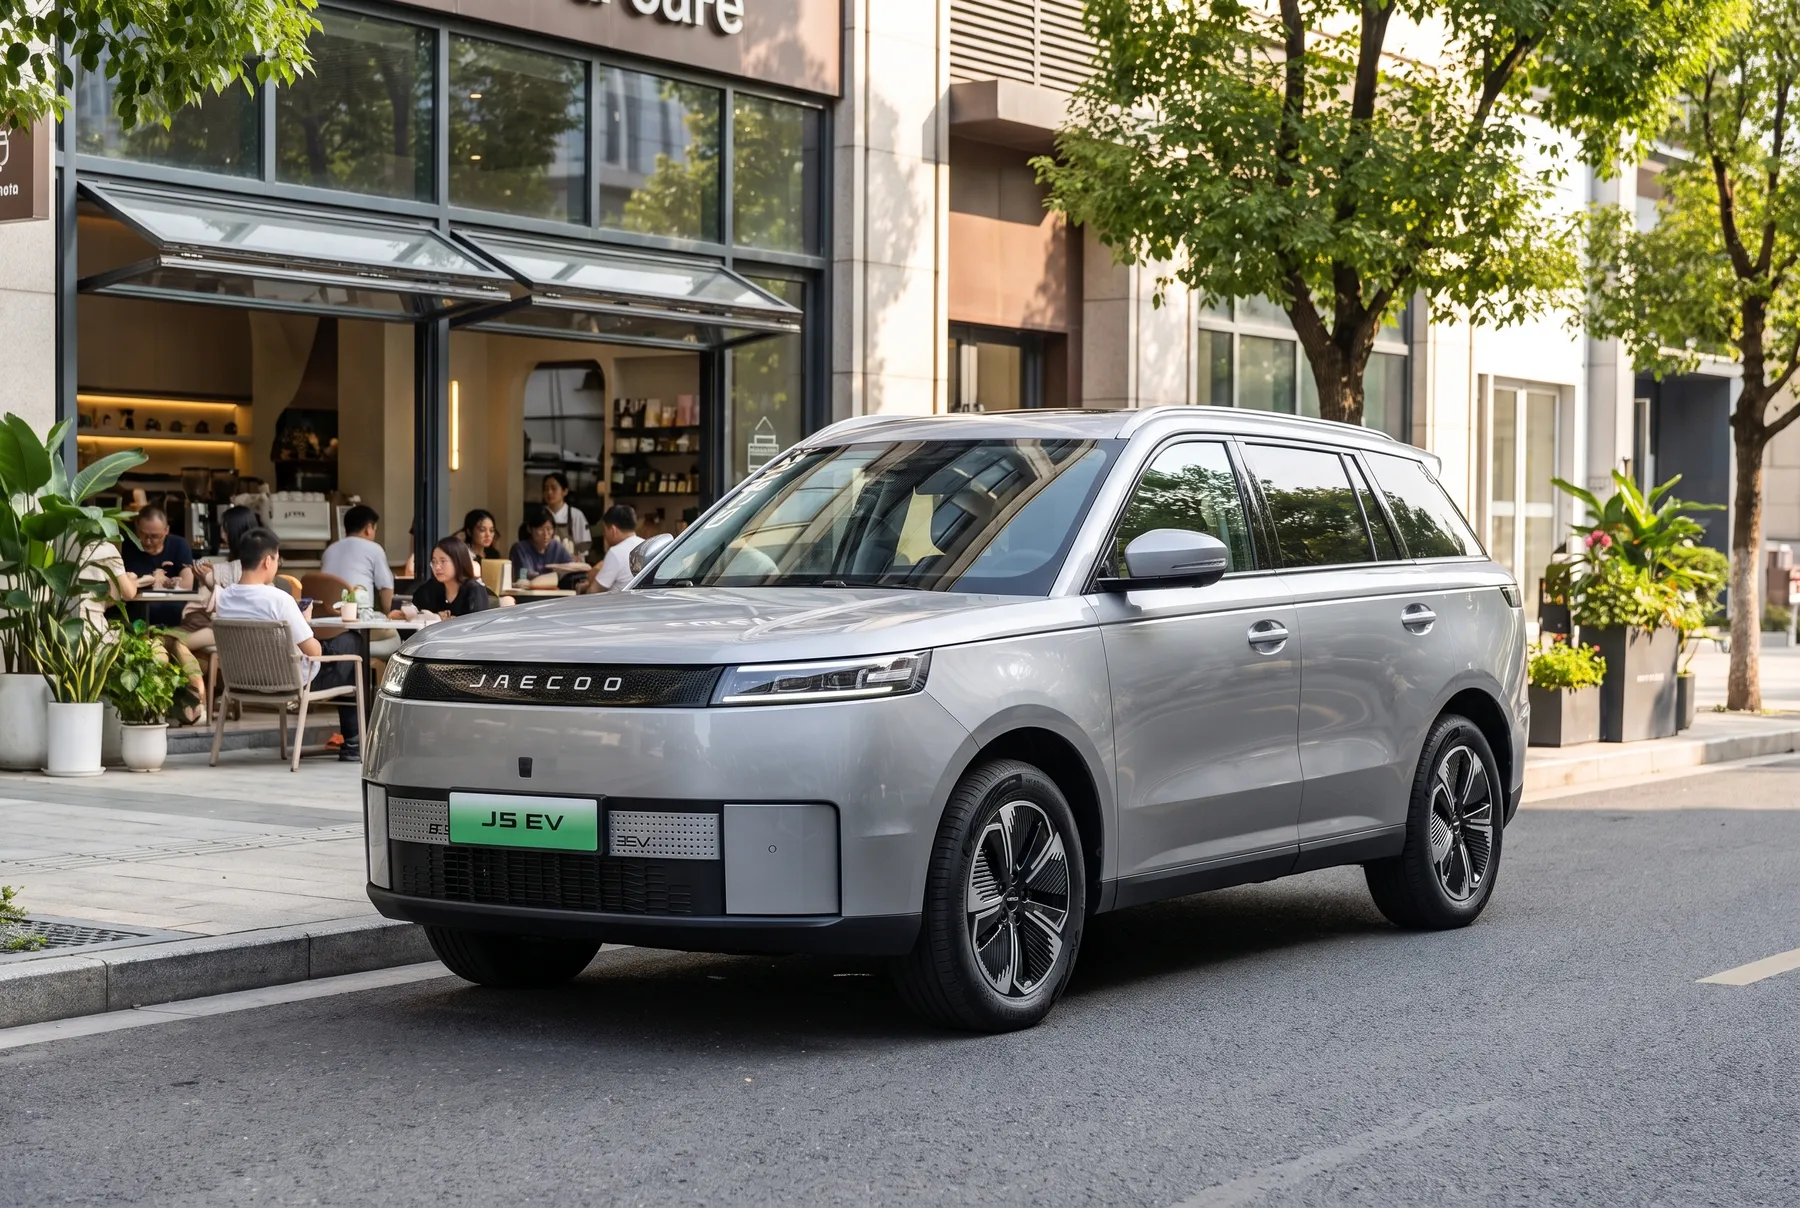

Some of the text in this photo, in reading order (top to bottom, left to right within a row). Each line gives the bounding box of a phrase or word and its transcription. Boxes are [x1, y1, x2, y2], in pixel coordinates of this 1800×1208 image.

[469, 674, 622, 691] JAECOO
[481, 811, 564, 831] J5 EV
